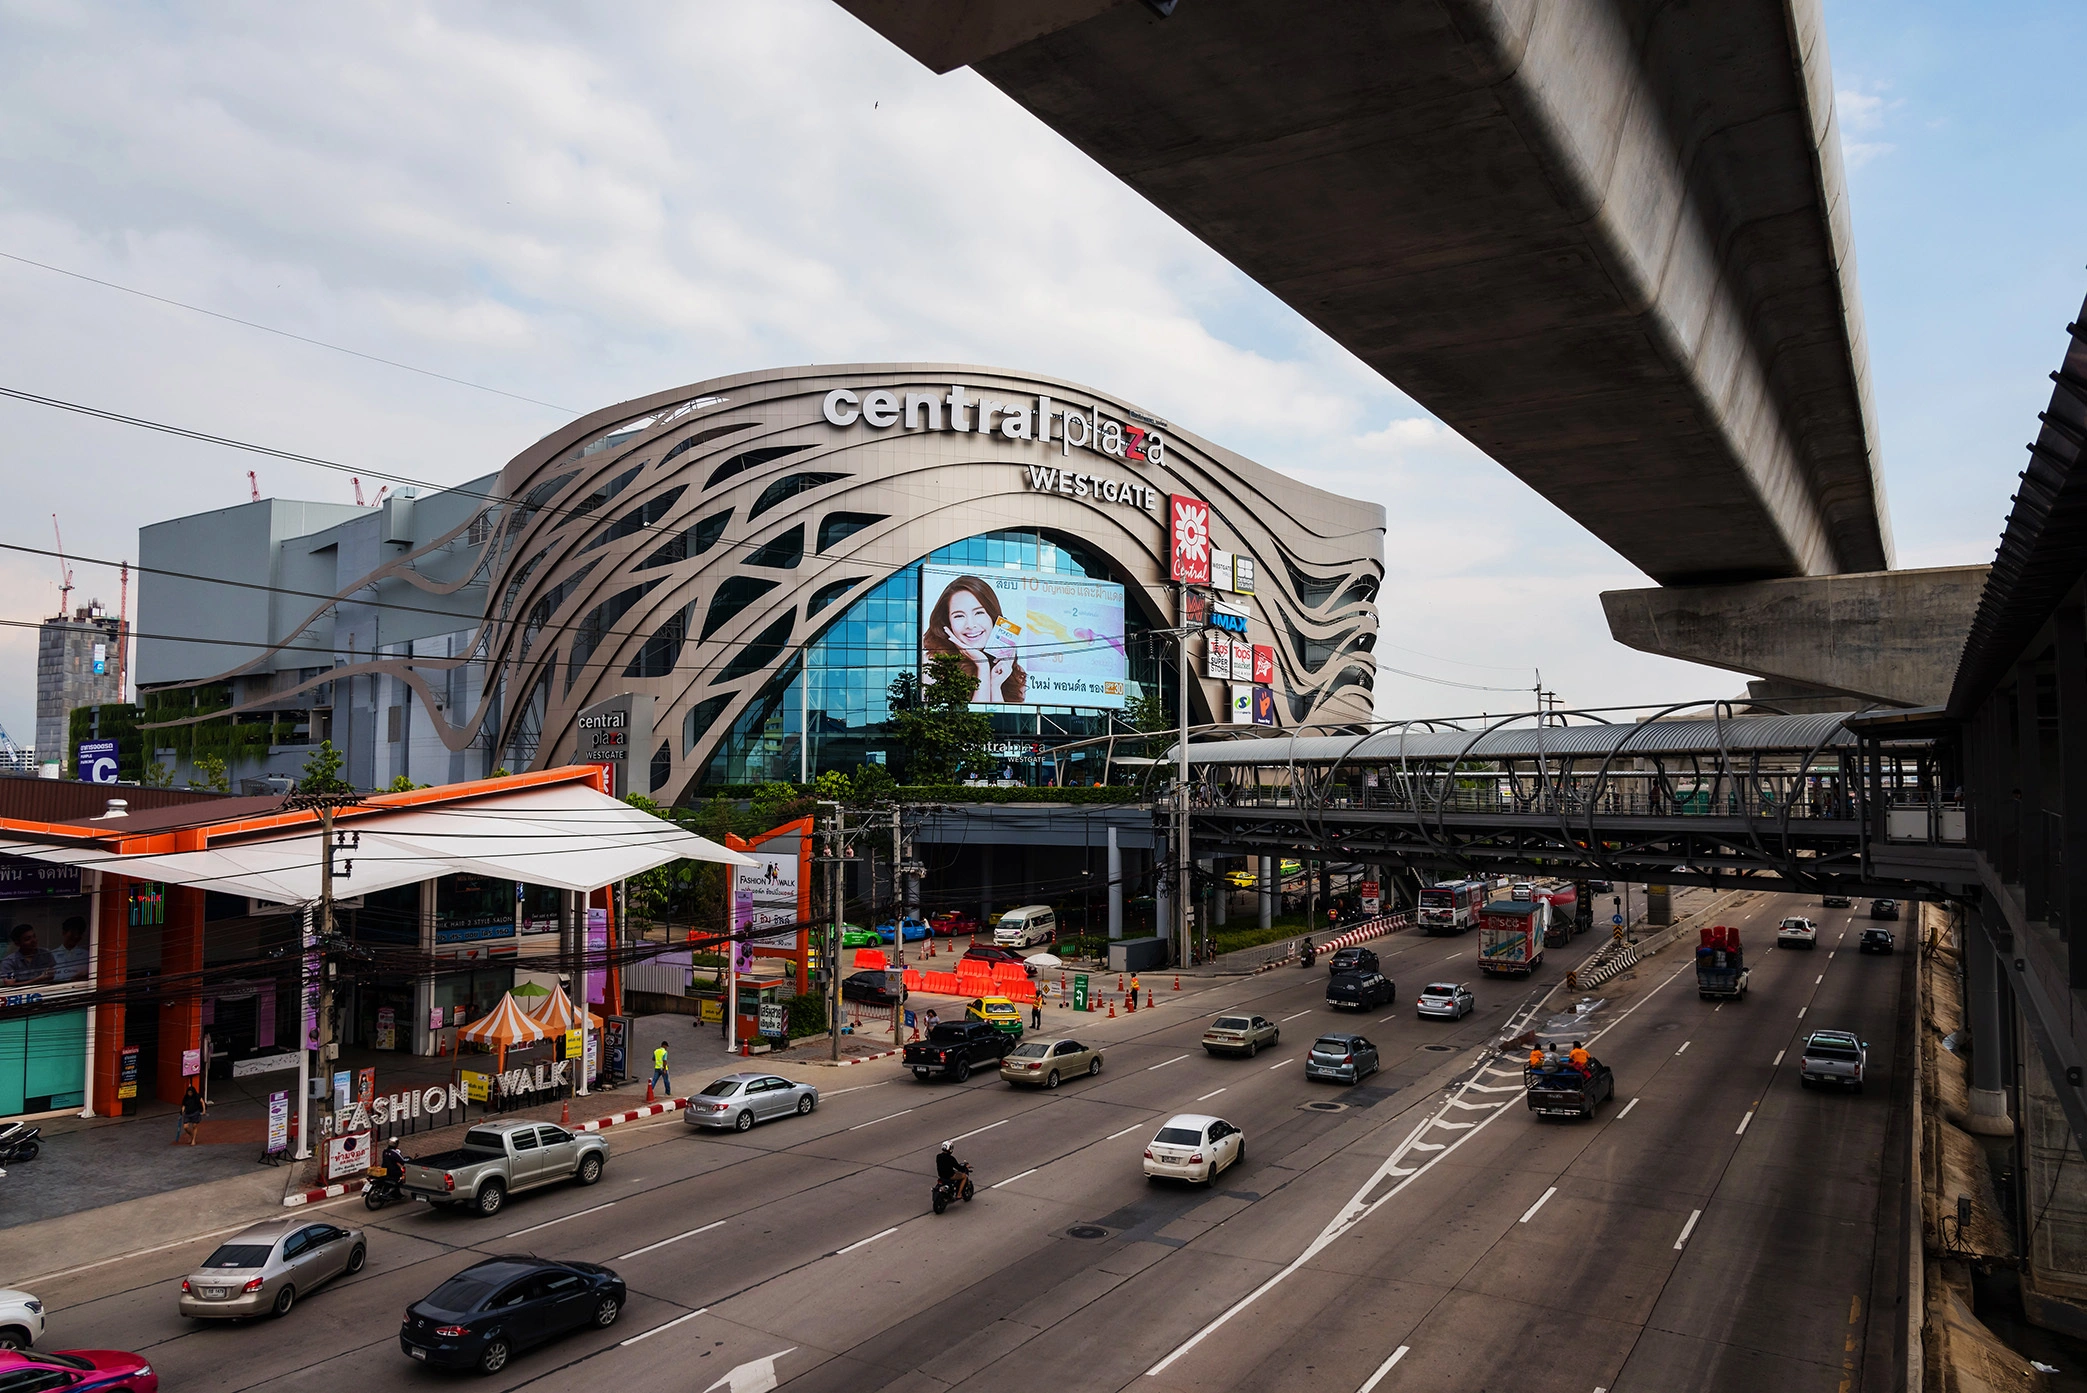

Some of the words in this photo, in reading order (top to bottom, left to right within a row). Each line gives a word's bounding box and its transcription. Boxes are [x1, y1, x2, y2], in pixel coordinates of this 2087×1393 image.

[1028, 465, 1157, 511] WESTGATE
[1173, 558, 1209, 581] Central
[1022, 576, 1039, 592] 10
[1072, 607, 1079, 617] 2
[1233, 646, 1251, 662] Tops
[1030, 676, 1050, 691] ใหม่
[1053, 679, 1087, 692] พอนด์ส
[578, 712, 624, 728] central
[592, 730, 624, 748] plaza
[586, 750, 624, 759] WESTGATE
[92, 757, 118, 783] C
[740, 875, 766, 885] FASHION
[778, 879, 795, 887] WALK
[1499, 918, 1520, 928] SCG
[335, 1080, 469, 1136] FASHION
[496, 1059, 570, 1099] WALK
